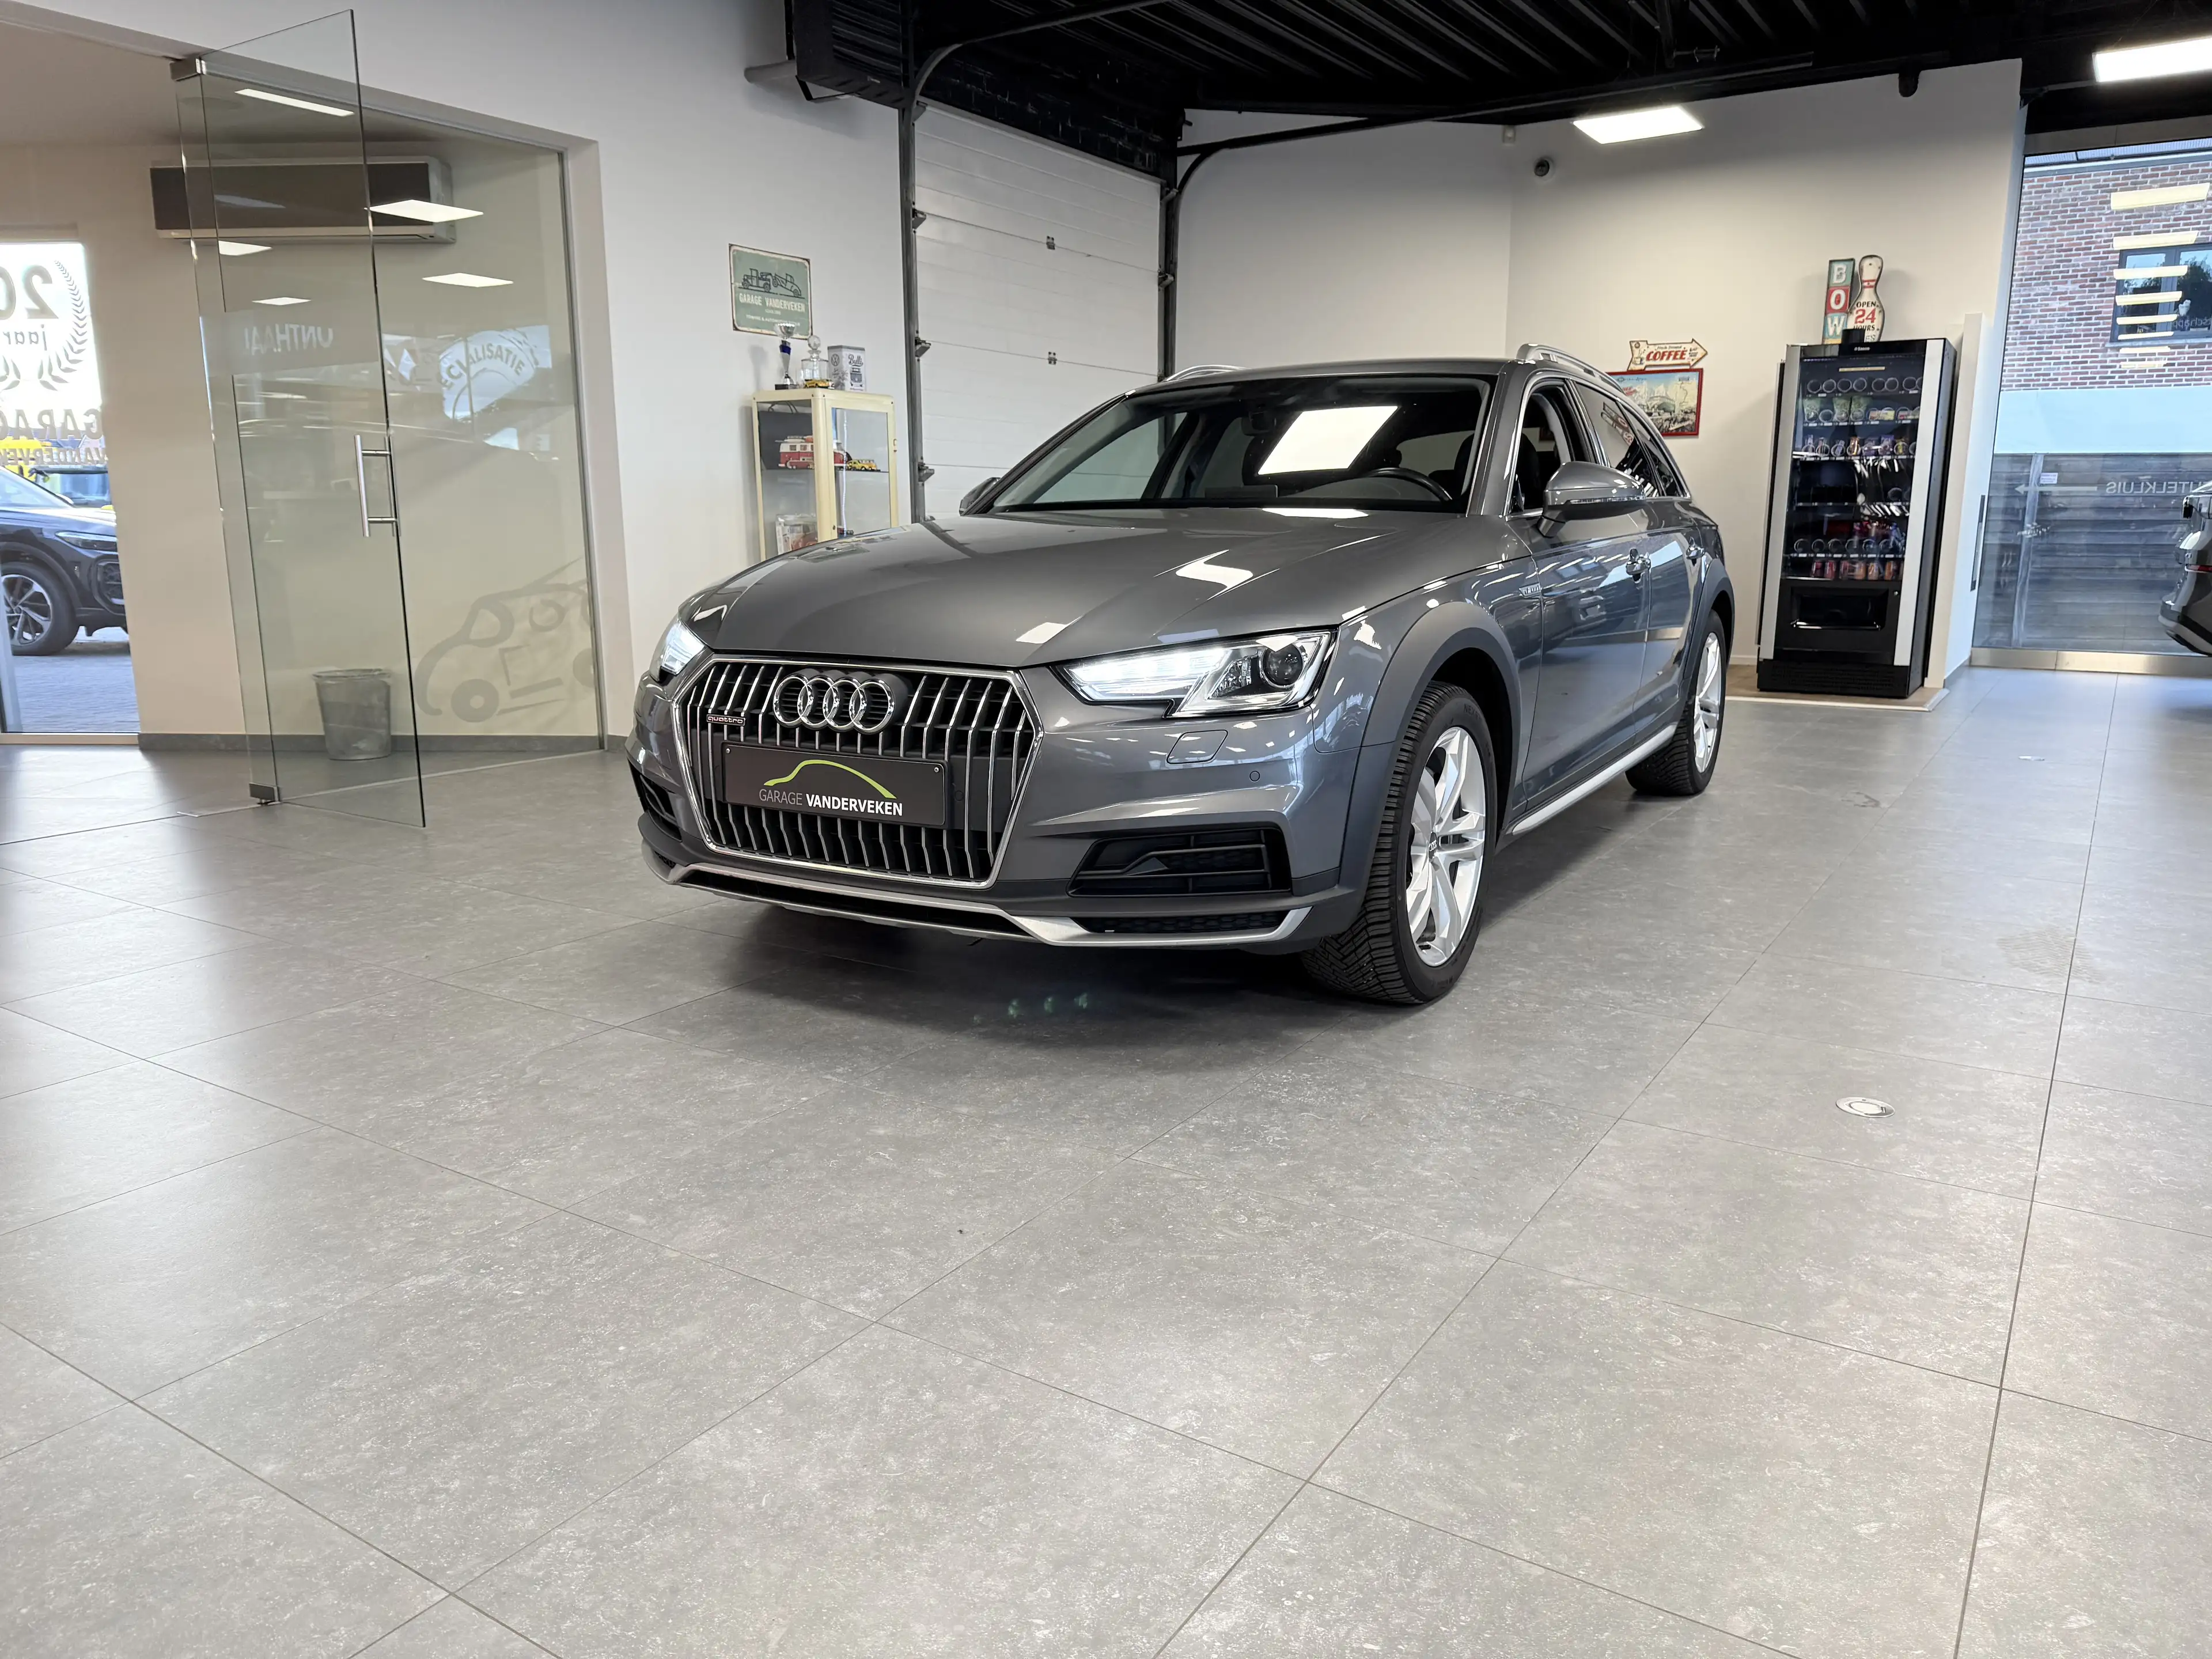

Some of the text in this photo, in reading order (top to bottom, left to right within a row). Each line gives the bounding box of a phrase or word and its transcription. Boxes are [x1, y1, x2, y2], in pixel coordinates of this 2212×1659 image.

[738, 293, 762, 306] GARAGE
[765, 297, 805, 312] VANDERVEKEN
[1854, 308, 1876, 324] 24
[849, 353, 863, 366] Bulli
[1646, 350, 1687, 361] COFFEE
[759, 788, 903, 816] GARAGE VANDERVEKEN
